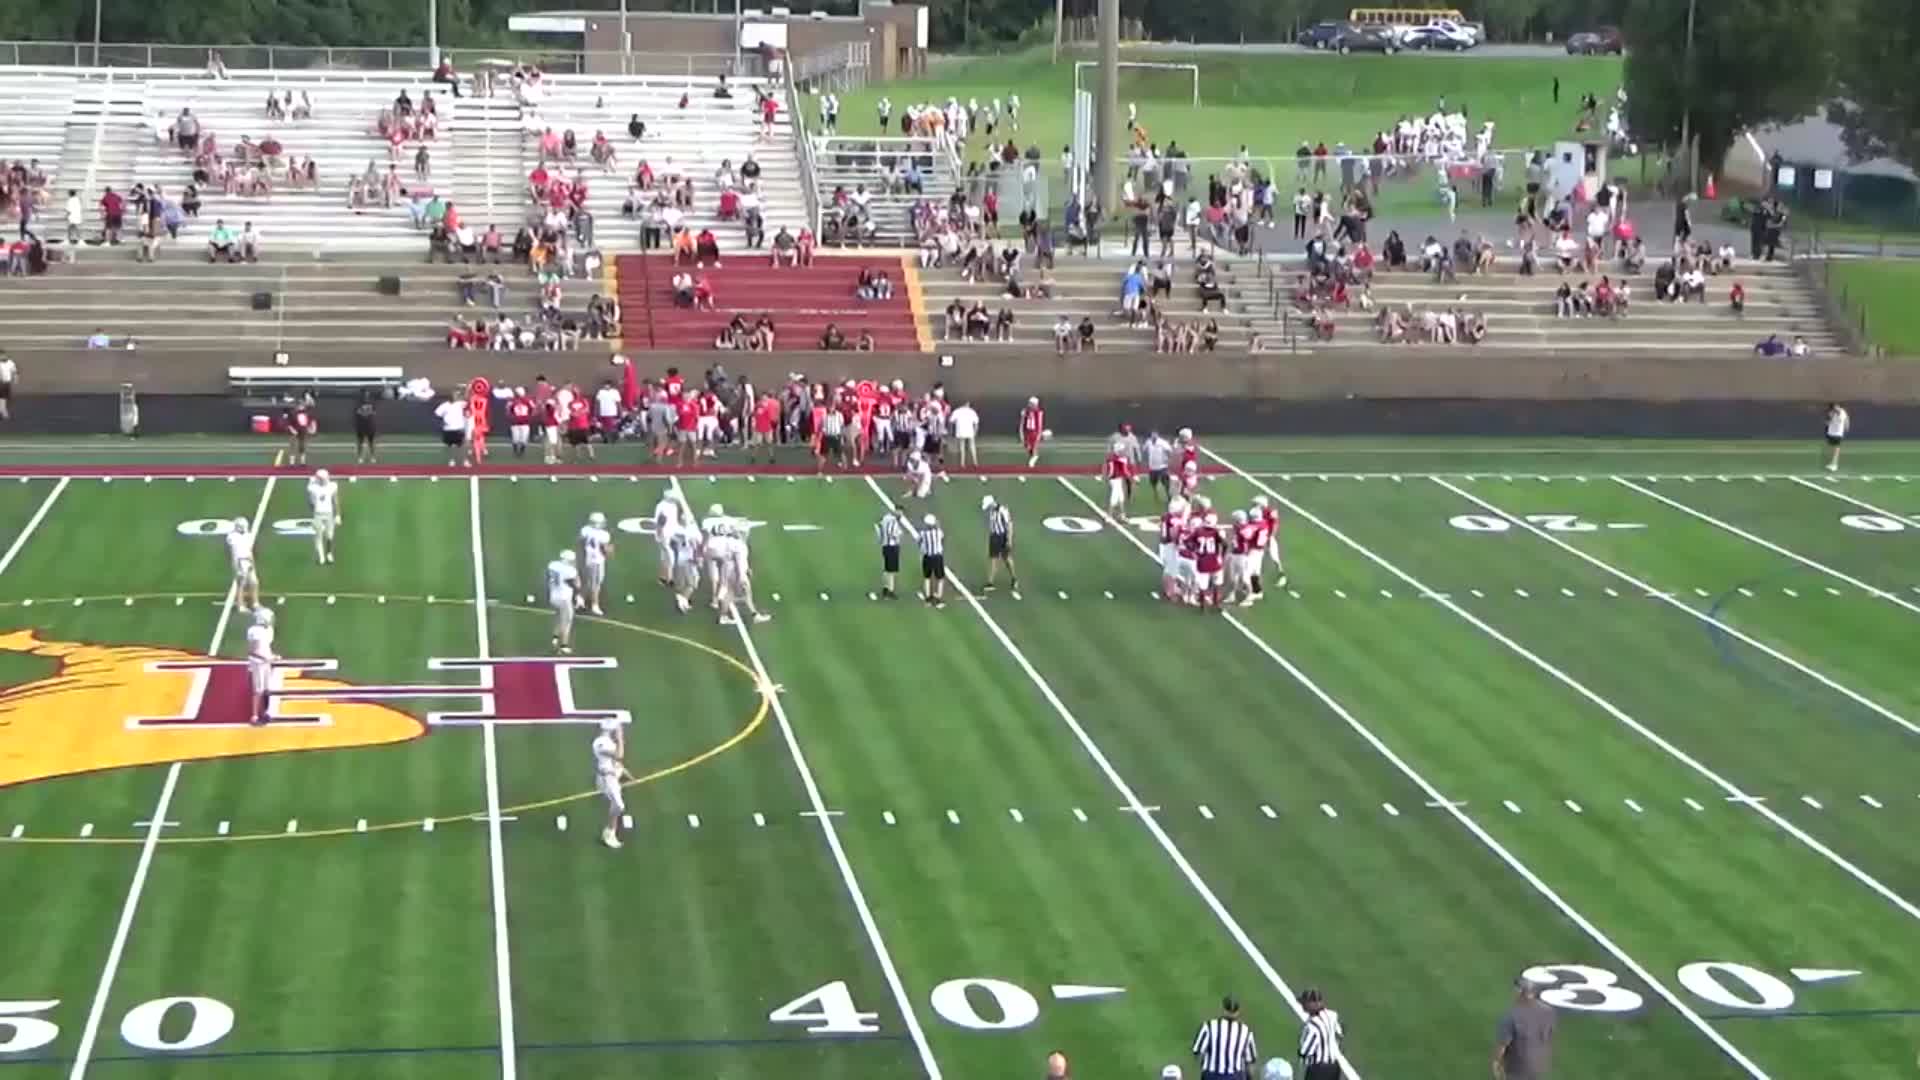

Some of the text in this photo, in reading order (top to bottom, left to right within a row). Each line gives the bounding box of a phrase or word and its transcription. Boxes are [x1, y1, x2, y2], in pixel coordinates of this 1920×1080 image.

[1449, 514, 1598, 532] 20
[769, 978, 1040, 1033] 40
[1522, 961, 1795, 1011] 30
